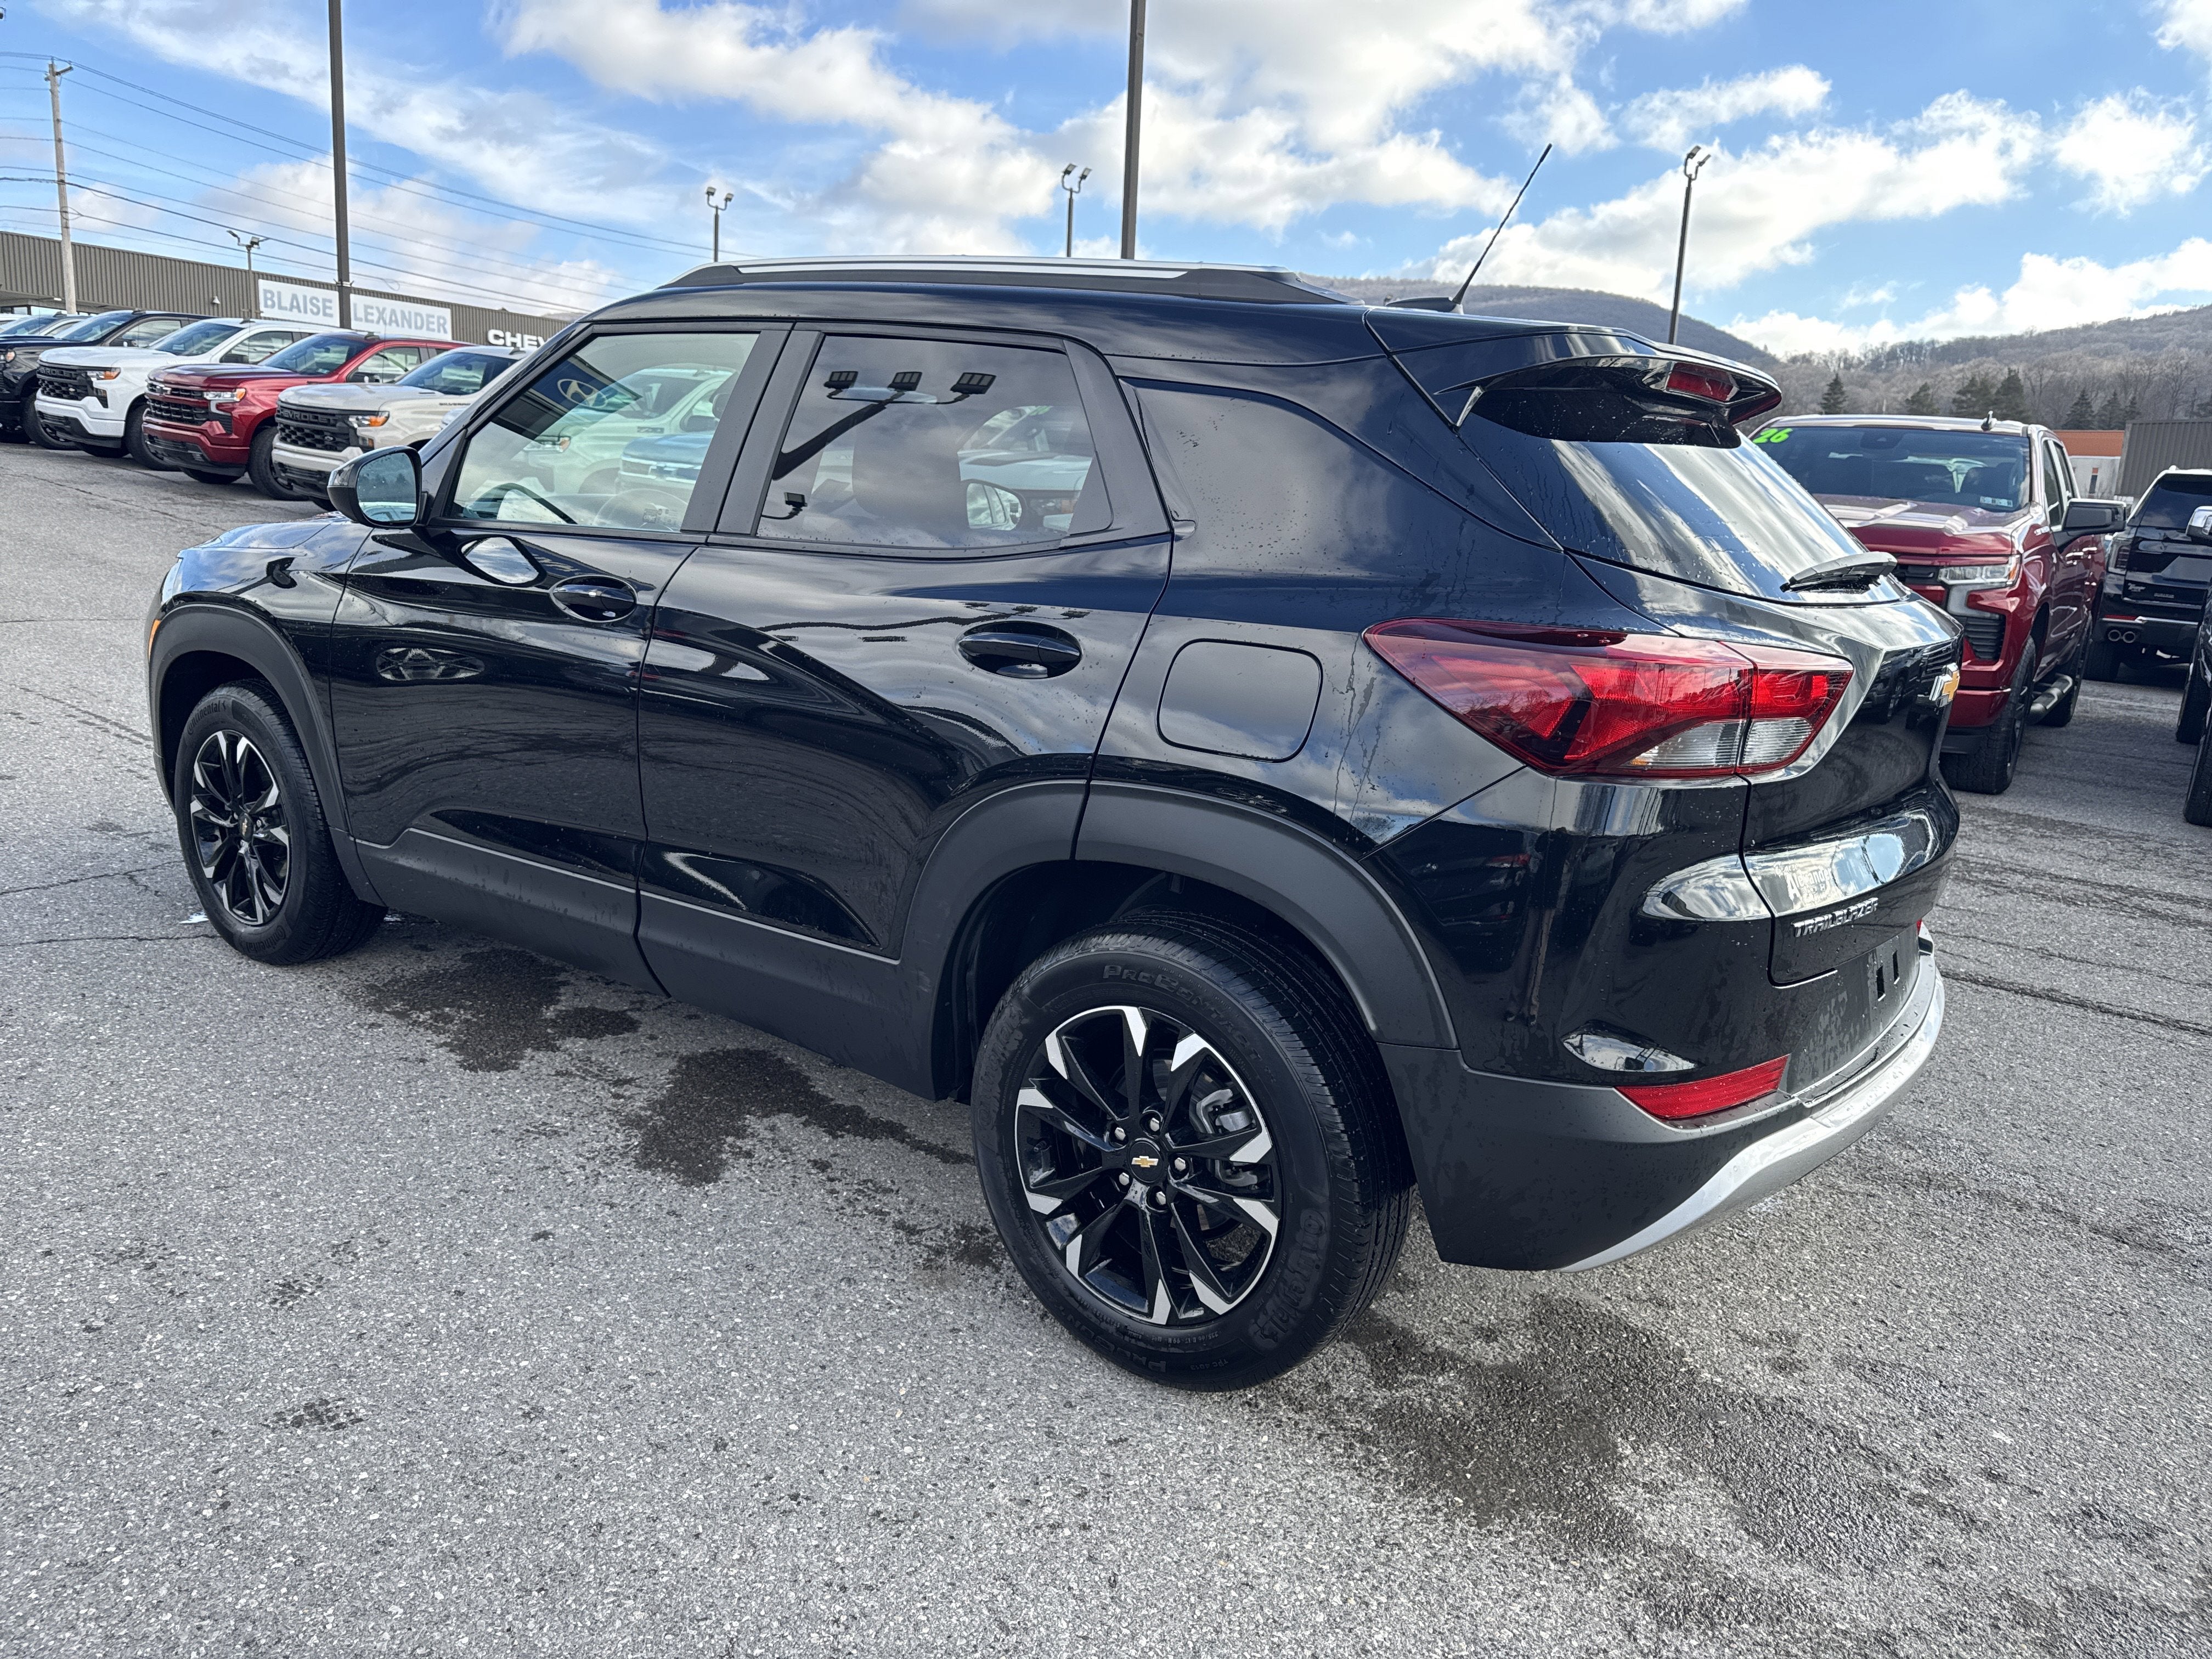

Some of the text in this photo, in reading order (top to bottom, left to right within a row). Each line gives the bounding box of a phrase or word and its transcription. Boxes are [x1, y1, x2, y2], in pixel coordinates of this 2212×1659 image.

[263, 289, 448, 334] BLAISE LEXANDER
[1752, 428, 1793, 443] 26
[1791, 897, 1879, 937] TRAILBLAZER
